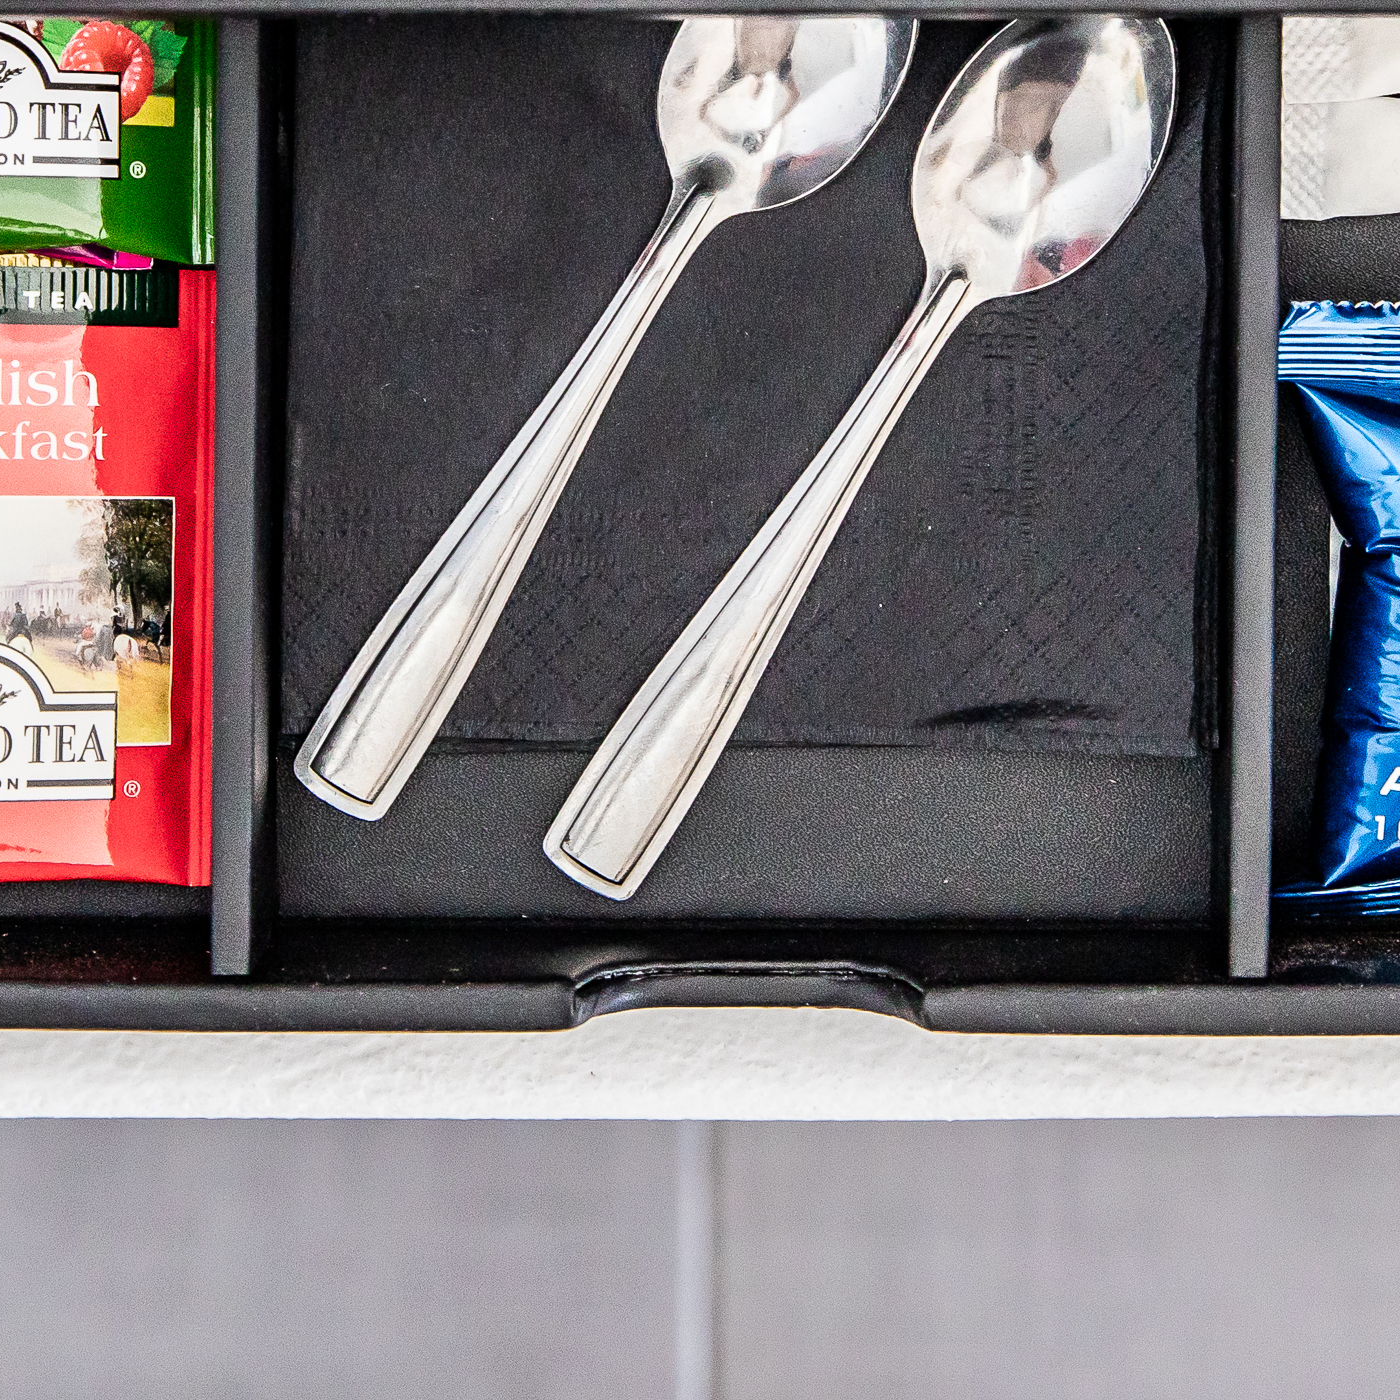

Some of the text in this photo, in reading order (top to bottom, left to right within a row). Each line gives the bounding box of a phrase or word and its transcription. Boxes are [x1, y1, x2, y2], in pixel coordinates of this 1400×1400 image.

[29, 102, 112, 142] TEA
[22, 290, 95, 310] TEA
[24, 723, 107, 763] TEA
